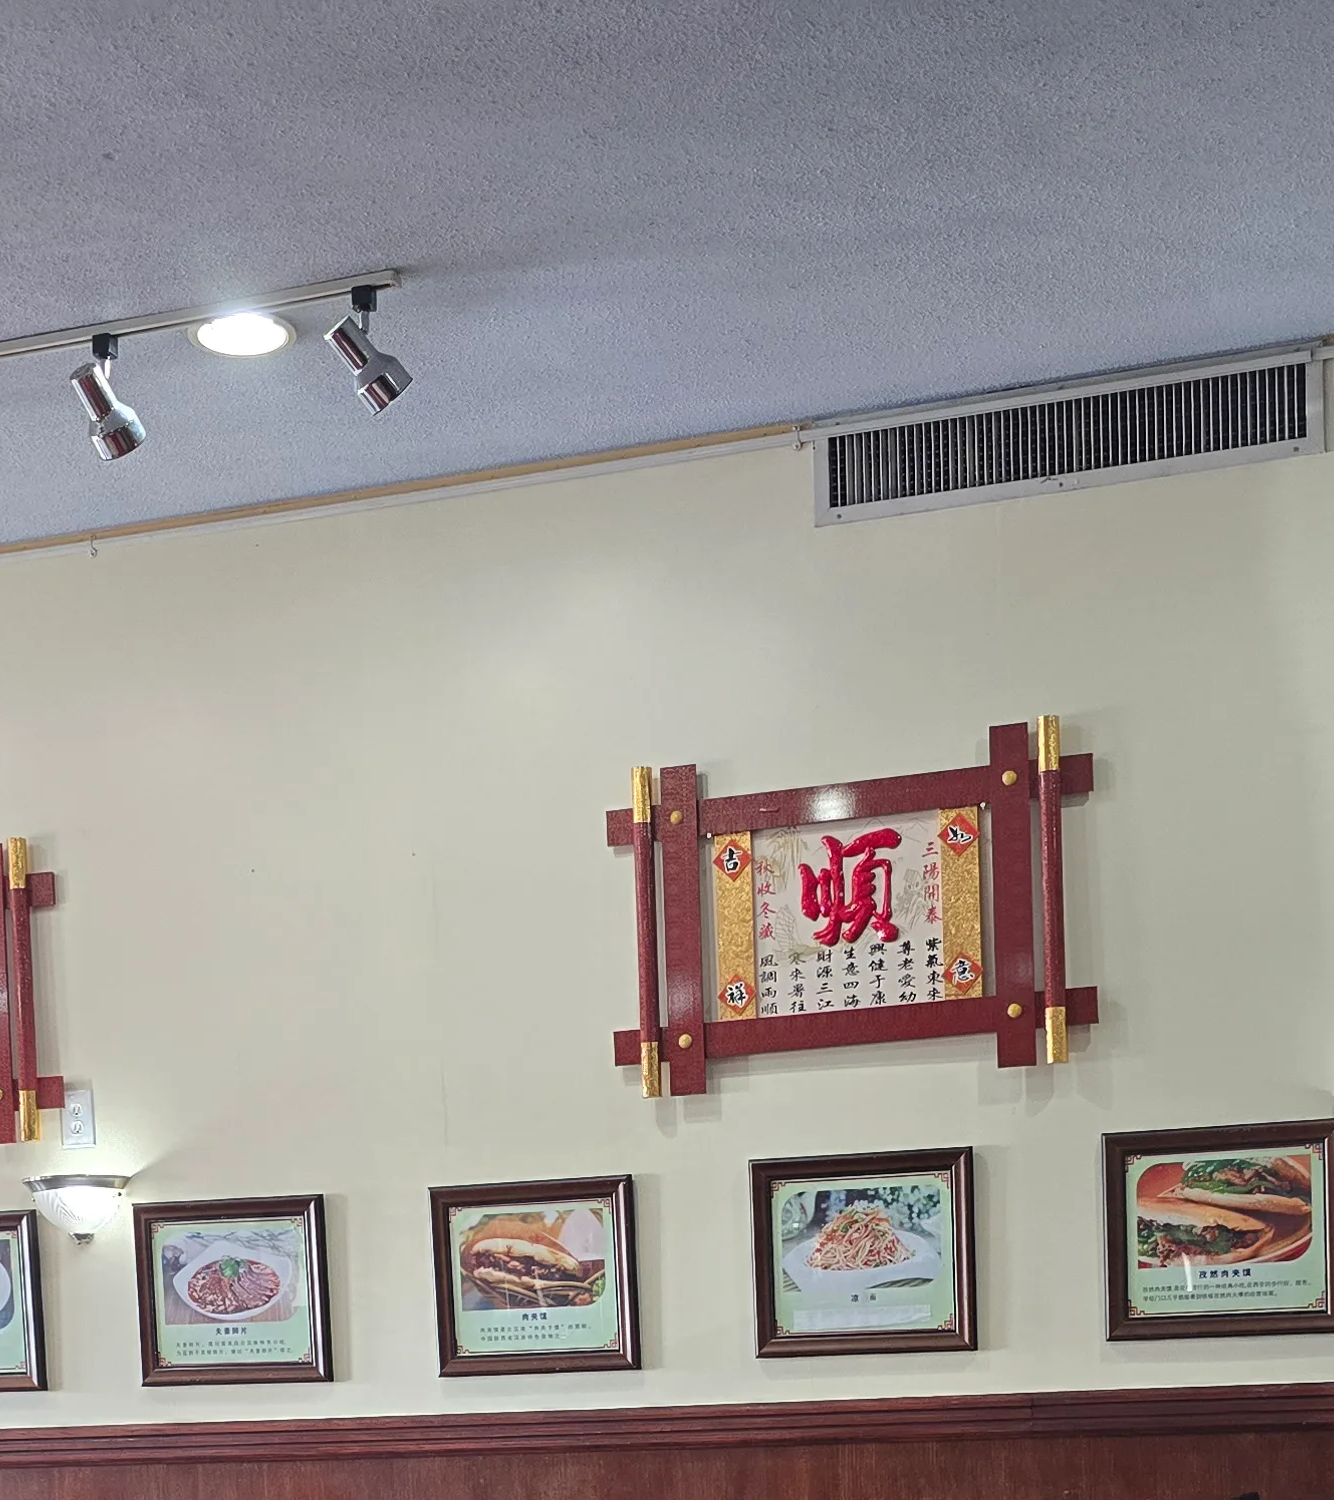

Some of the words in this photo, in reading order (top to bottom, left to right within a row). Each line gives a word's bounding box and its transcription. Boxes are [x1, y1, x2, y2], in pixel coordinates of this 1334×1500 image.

[722, 848, 740, 872] 吉
[798, 828, 903, 948] 順
[921, 841, 943, 925] 三陽開泰
[754, 857, 777, 942] 秋收冬藏
[724, 984, 746, 1006] 祥
[759, 954, 778, 1015] 風調雨順
[788, 952, 807, 1013] 寒來暑往
[816, 949, 835, 1010] 財源三江
[842, 946, 862, 1009] 生意四海
[897, 940, 917, 1003] 尊老愛幼
[925, 937, 944, 1001] 紫氣東來
[951, 961, 973, 982] 意
